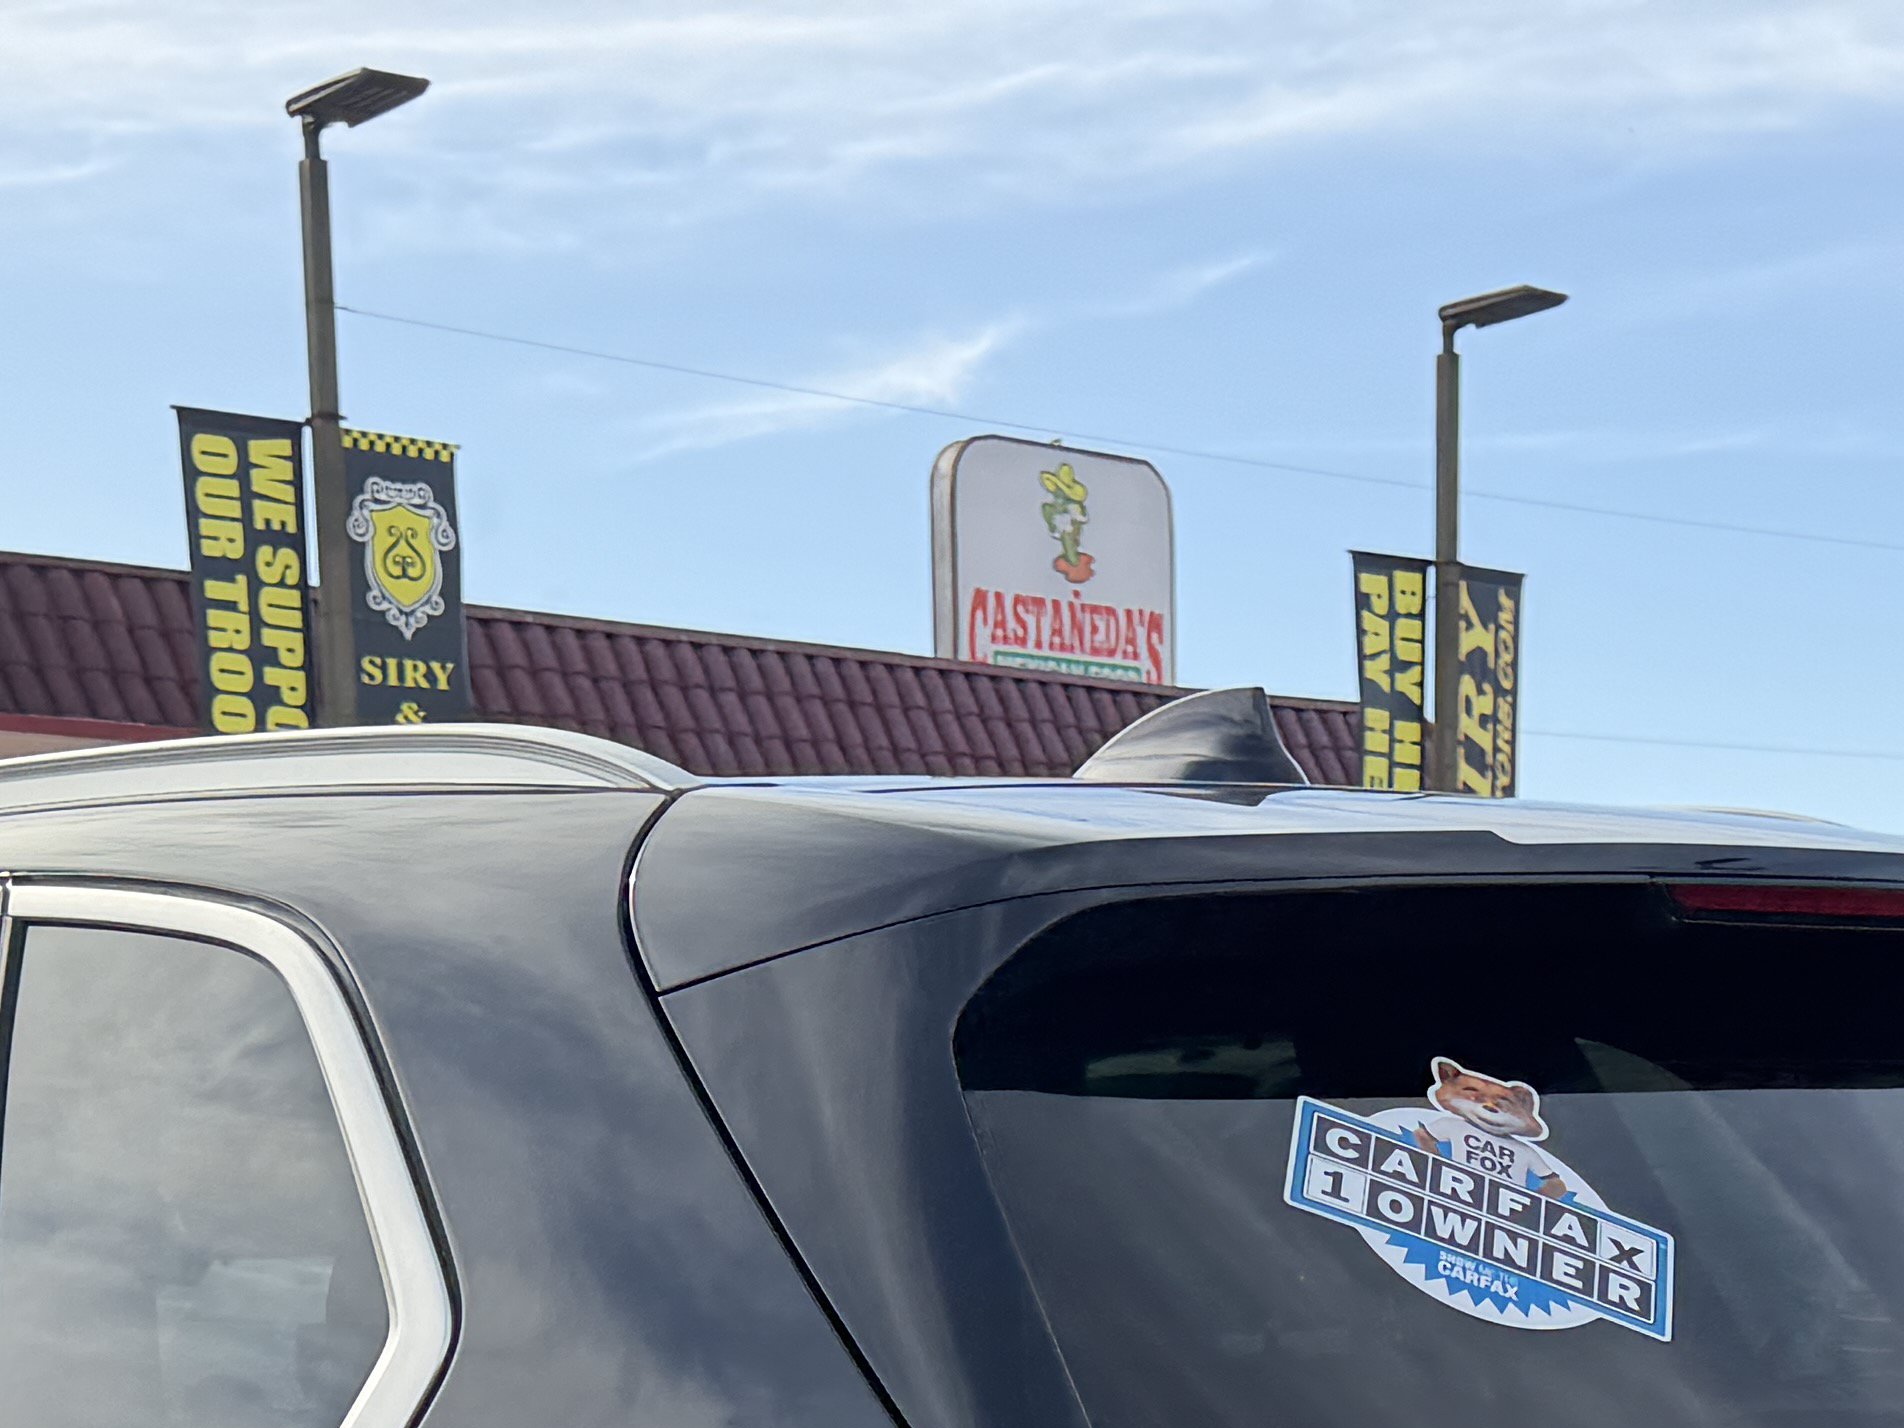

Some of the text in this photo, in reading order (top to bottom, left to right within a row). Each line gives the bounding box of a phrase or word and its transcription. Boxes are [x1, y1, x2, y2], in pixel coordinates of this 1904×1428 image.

[191, 433, 256, 733] OUR TROO
[247, 438, 309, 731] WE SUPPO
[1359, 572, 1390, 693] PAY
[1393, 570, 1422, 706] BUY
[360, 655, 455, 691] SIRY
[395, 701, 426, 724] &
[1456, 580, 1495, 797] IRY
[1325, 1127, 1645, 1272] CARFAX
[1464, 1134, 1515, 1164] CAR
[1466, 1151, 1513, 1179] FOX
[1377, 1190, 1641, 1312] OWNER
[1438, 1260, 1519, 1302] CARFAX
